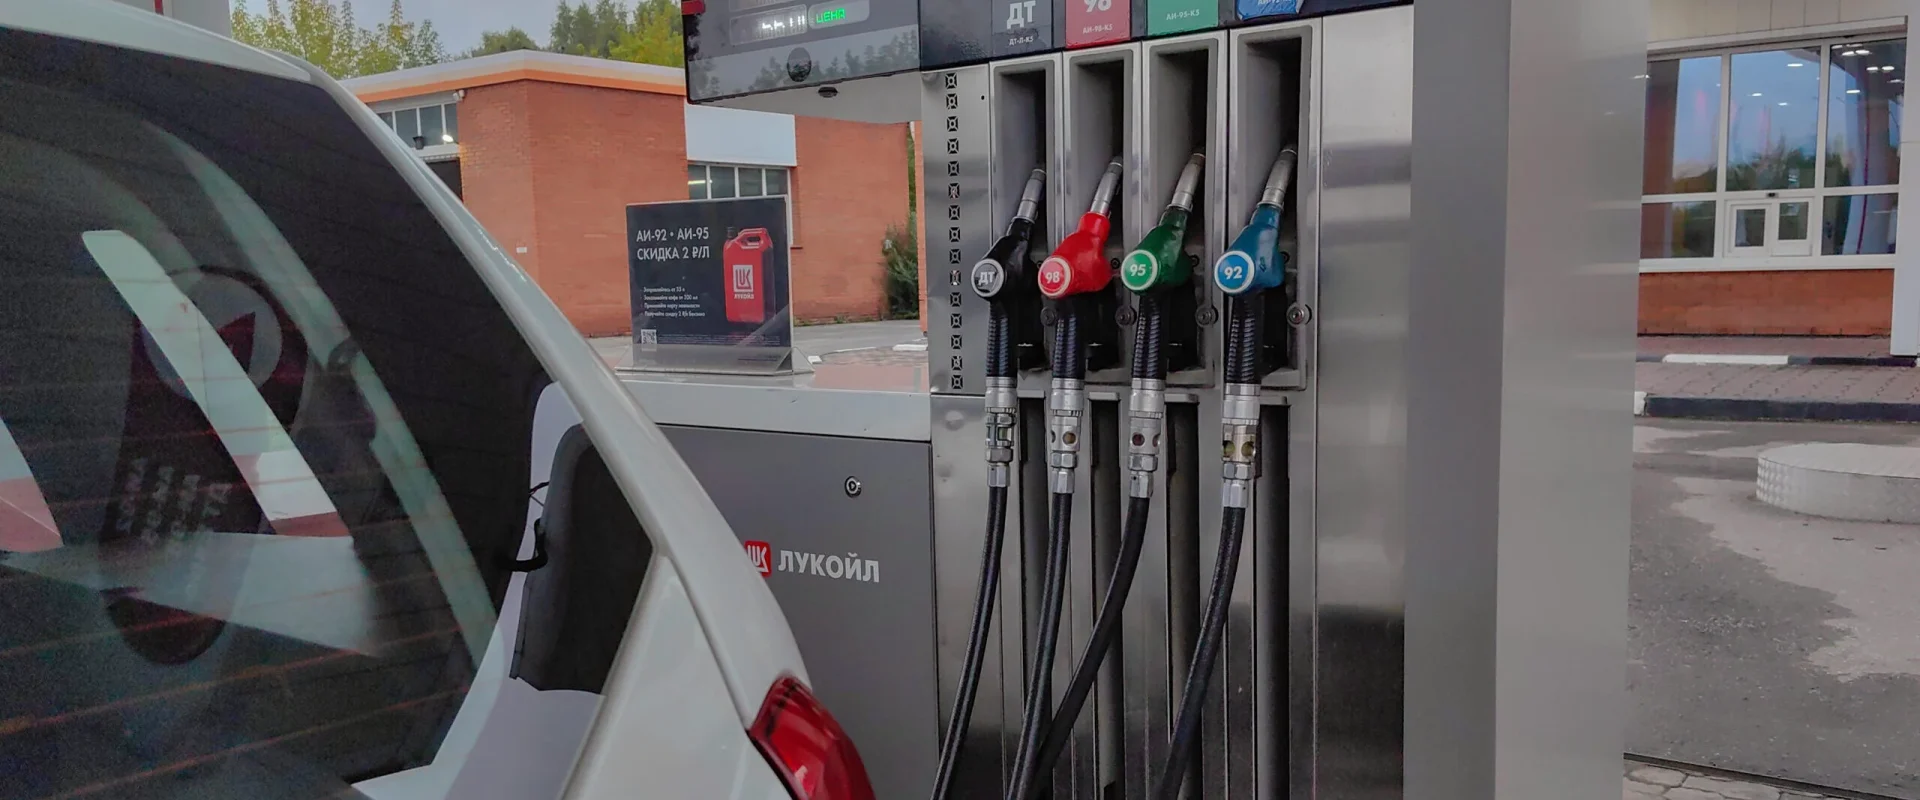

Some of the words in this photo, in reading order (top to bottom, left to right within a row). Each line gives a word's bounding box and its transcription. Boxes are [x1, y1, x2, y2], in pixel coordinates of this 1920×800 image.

[1006, 0, 1036, 30] ДТ
[1166, 9, 1200, 21] АИ-95-К5
[1082, 24, 1113, 34] АИ-98-К5
[636, 229, 667, 242] АИ-92
[677, 227, 709, 240] АИ-95
[637, 247, 680, 261] СКИДКА
[682, 247, 689, 259] 2
[692, 246, 710, 259] ₽/Л
[1045, 271, 1061, 283] 98
[1130, 264, 1147, 277] 95
[1224, 266, 1243, 280] 92
[978, 271, 995, 286] ДТ
[778, 549, 880, 583] ЛУКОЙЛ
